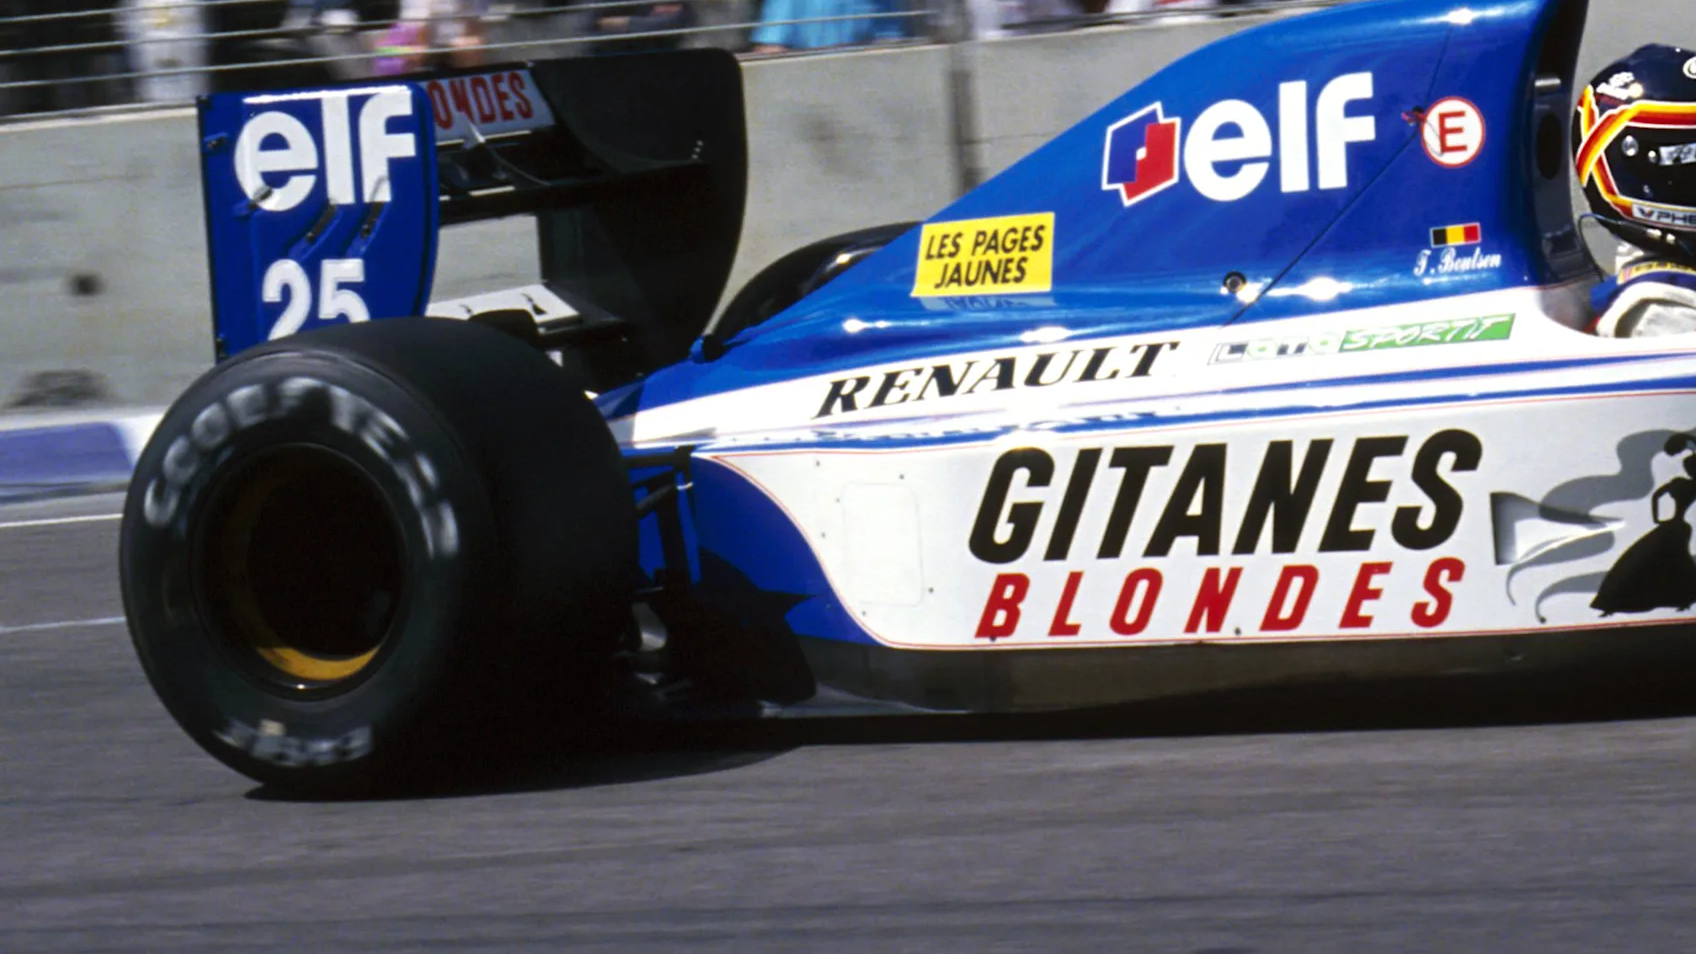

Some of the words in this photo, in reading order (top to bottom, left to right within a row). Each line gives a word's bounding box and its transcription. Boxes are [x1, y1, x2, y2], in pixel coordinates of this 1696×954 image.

[233, 90, 417, 212] elf
[1184, 71, 1376, 202] elf
[1439, 110, 1467, 153] E
[925, 232, 964, 261] LES
[970, 224, 1047, 257] PAGES
[933, 256, 1029, 290] JAUNES
[261, 257, 371, 341] 25
[812, 341, 1180, 419] RENAULT
[967, 428, 1483, 565] GITANES
[973, 555, 1467, 640] BLONDES
